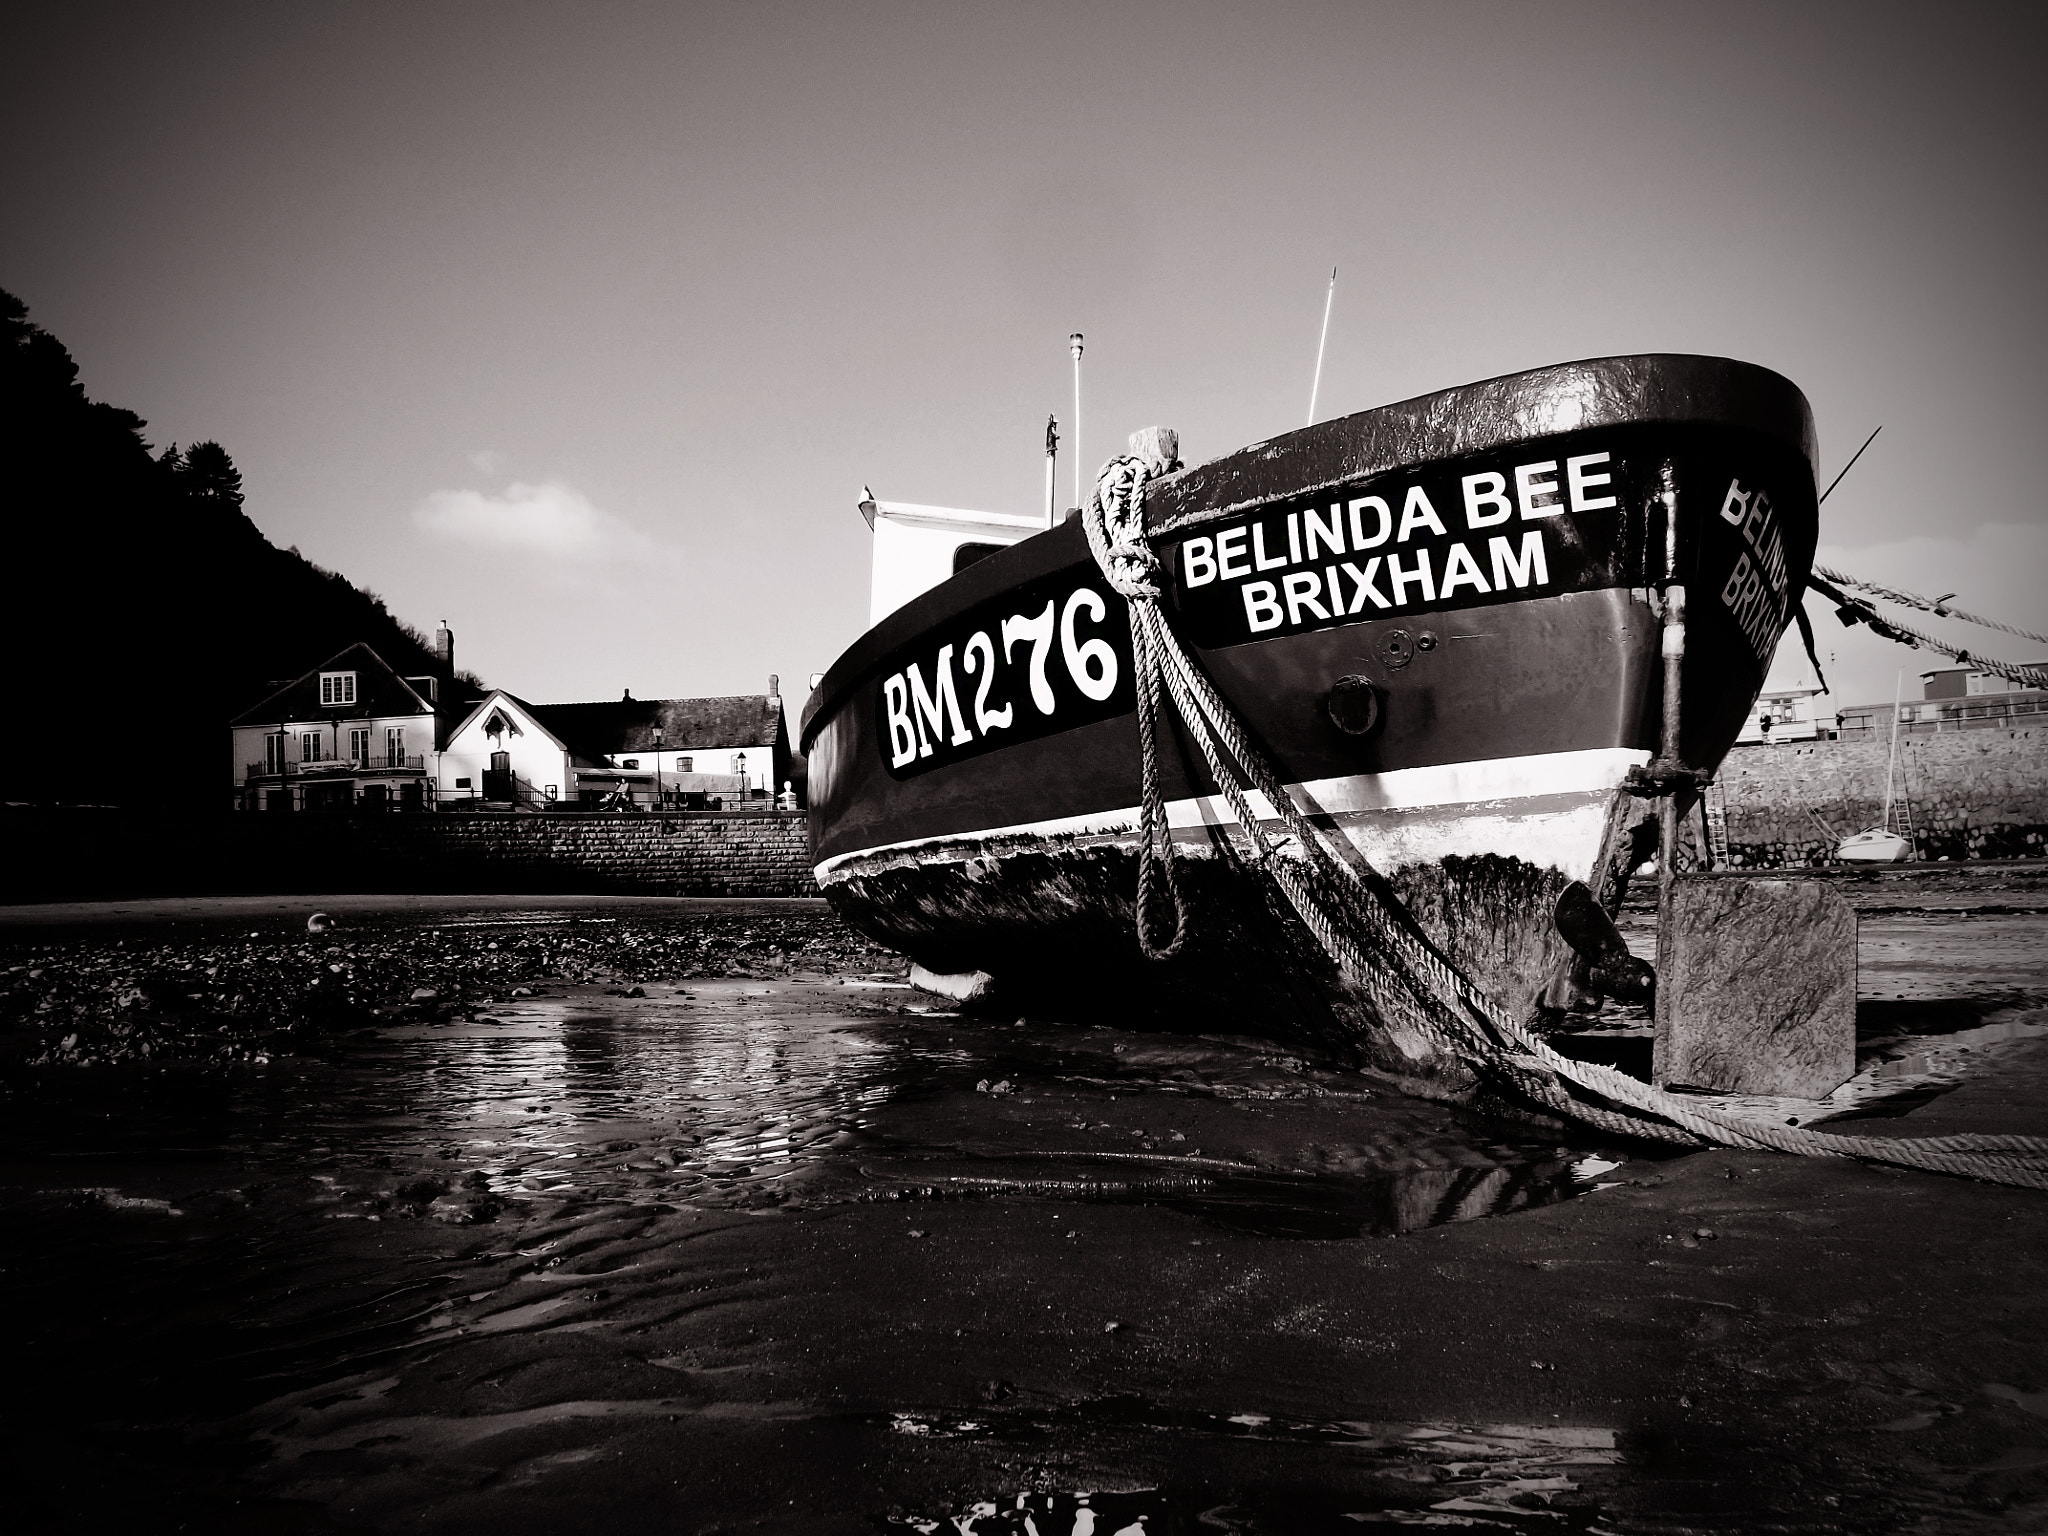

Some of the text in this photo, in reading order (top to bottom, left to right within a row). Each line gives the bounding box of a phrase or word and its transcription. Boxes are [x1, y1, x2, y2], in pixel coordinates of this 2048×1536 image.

[1182, 452, 1617, 588] BELINDA BEE
[1241, 530, 1549, 633] BRIXHAM
[884, 588, 1118, 769] BM276
